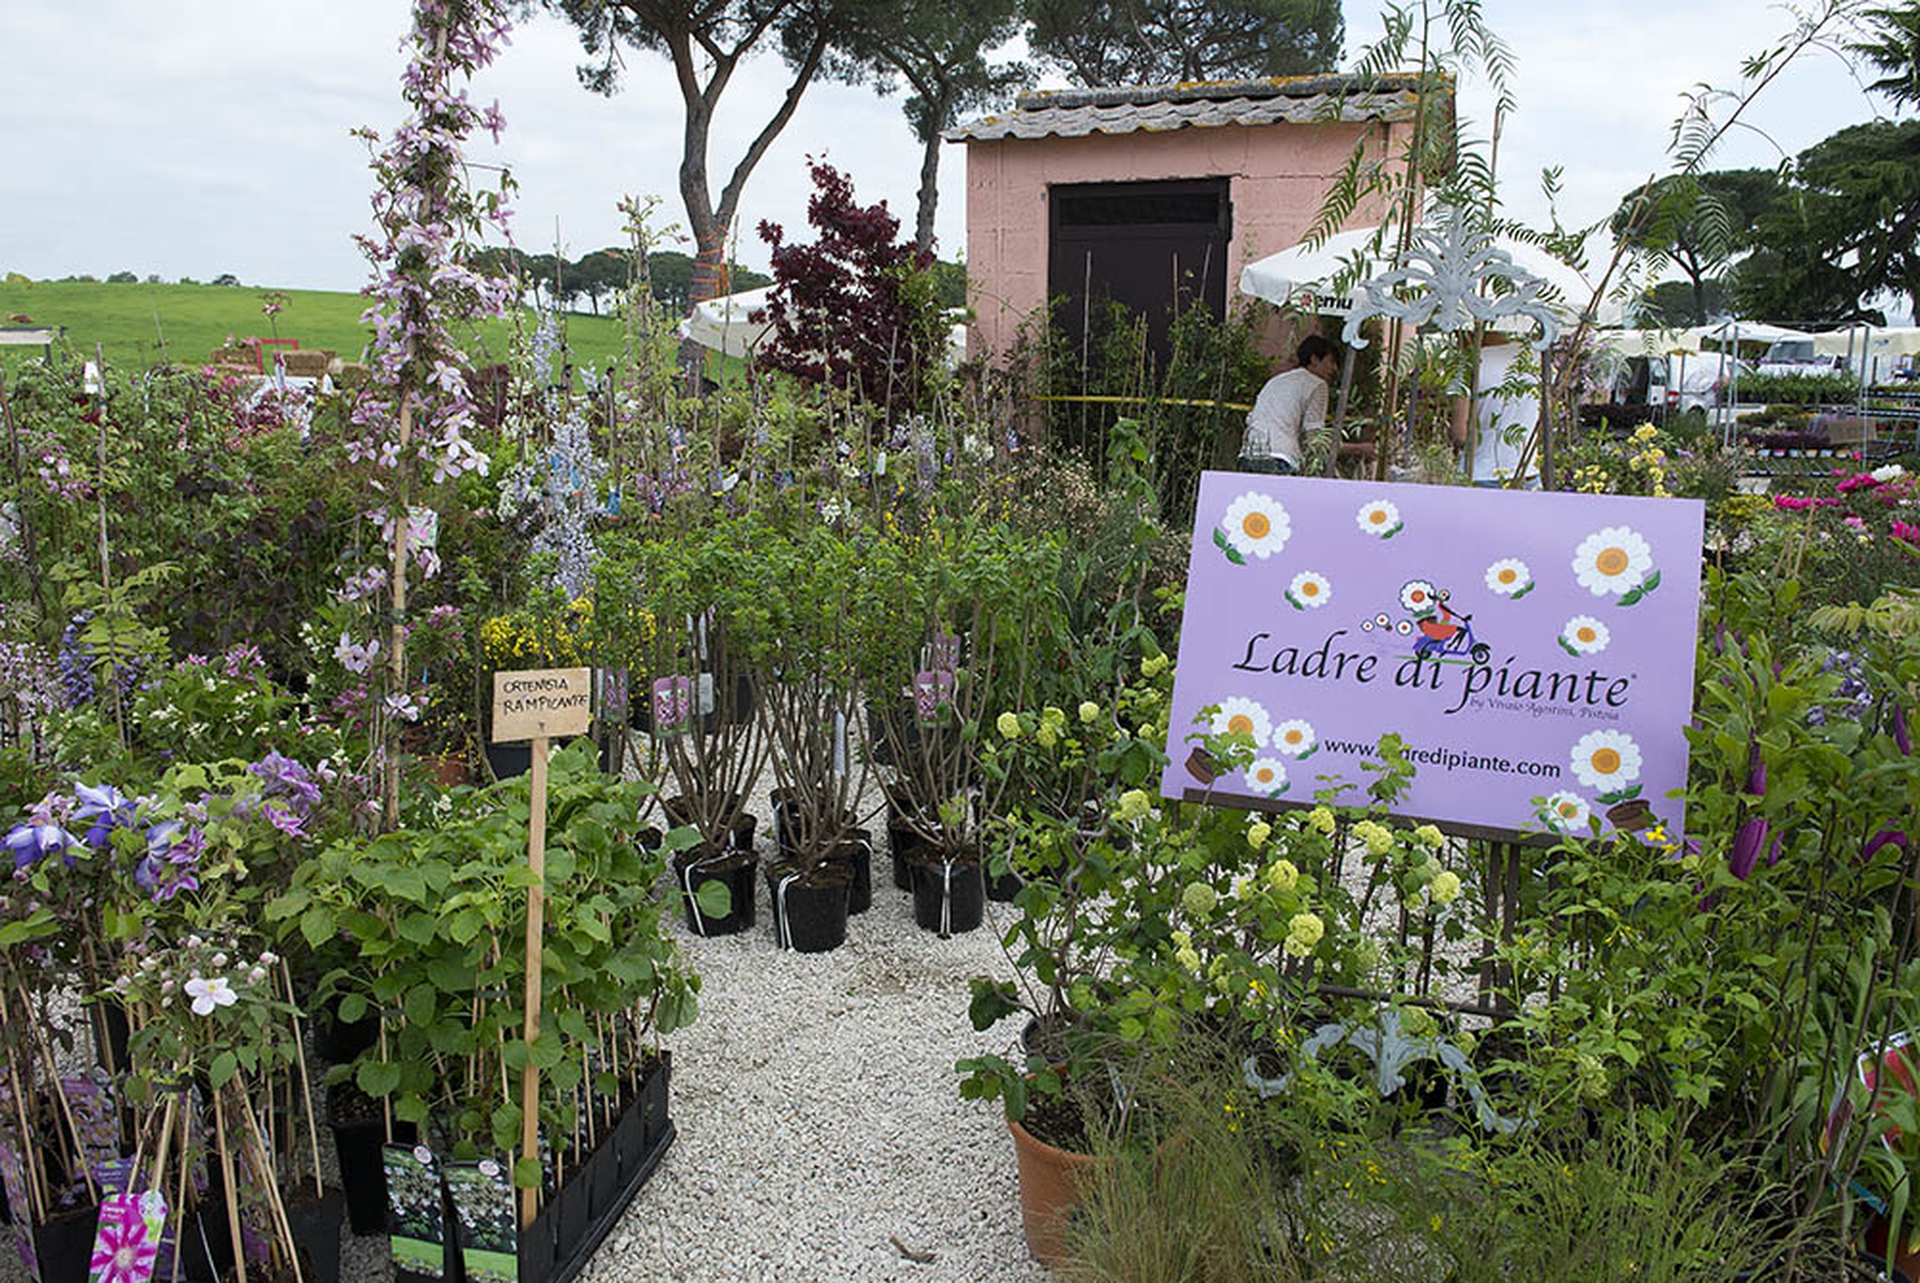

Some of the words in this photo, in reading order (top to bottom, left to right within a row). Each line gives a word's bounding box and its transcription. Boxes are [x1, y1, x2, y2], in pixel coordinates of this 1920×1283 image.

[1317, 295, 1353, 310] emu
[1232, 630, 1378, 683] Ladre
[1394, 640, 1444, 690] di
[1443, 655, 1630, 715] piante
[503, 678, 569, 694] ORTENSIA
[503, 694, 588, 716] RAMPICANTE
[1324, 738, 1561, 778] www.dredipiante.com
